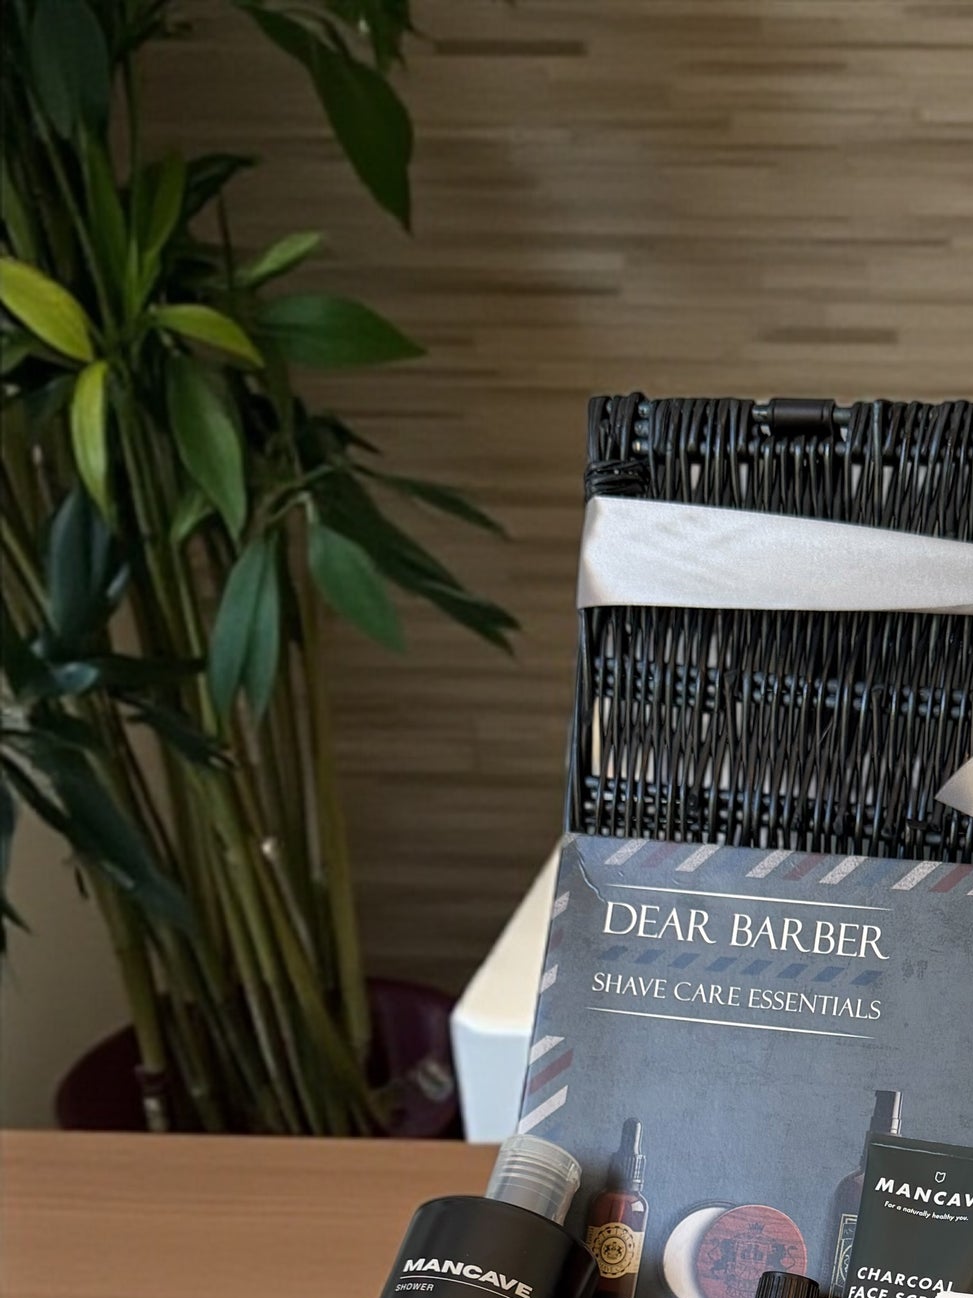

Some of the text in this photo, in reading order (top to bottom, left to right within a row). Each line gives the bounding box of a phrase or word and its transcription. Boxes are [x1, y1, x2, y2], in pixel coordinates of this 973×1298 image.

[602, 901, 890, 960] DEAR BARBER
[591, 972, 882, 1020] SHAVE CARE ESSENTIALS
[884, 1201, 896, 1209] For
[902, 1207, 931, 1219] naturally
[931, 1212, 955, 1222] healthy
[395, 1283, 434, 1292] SHOWER
